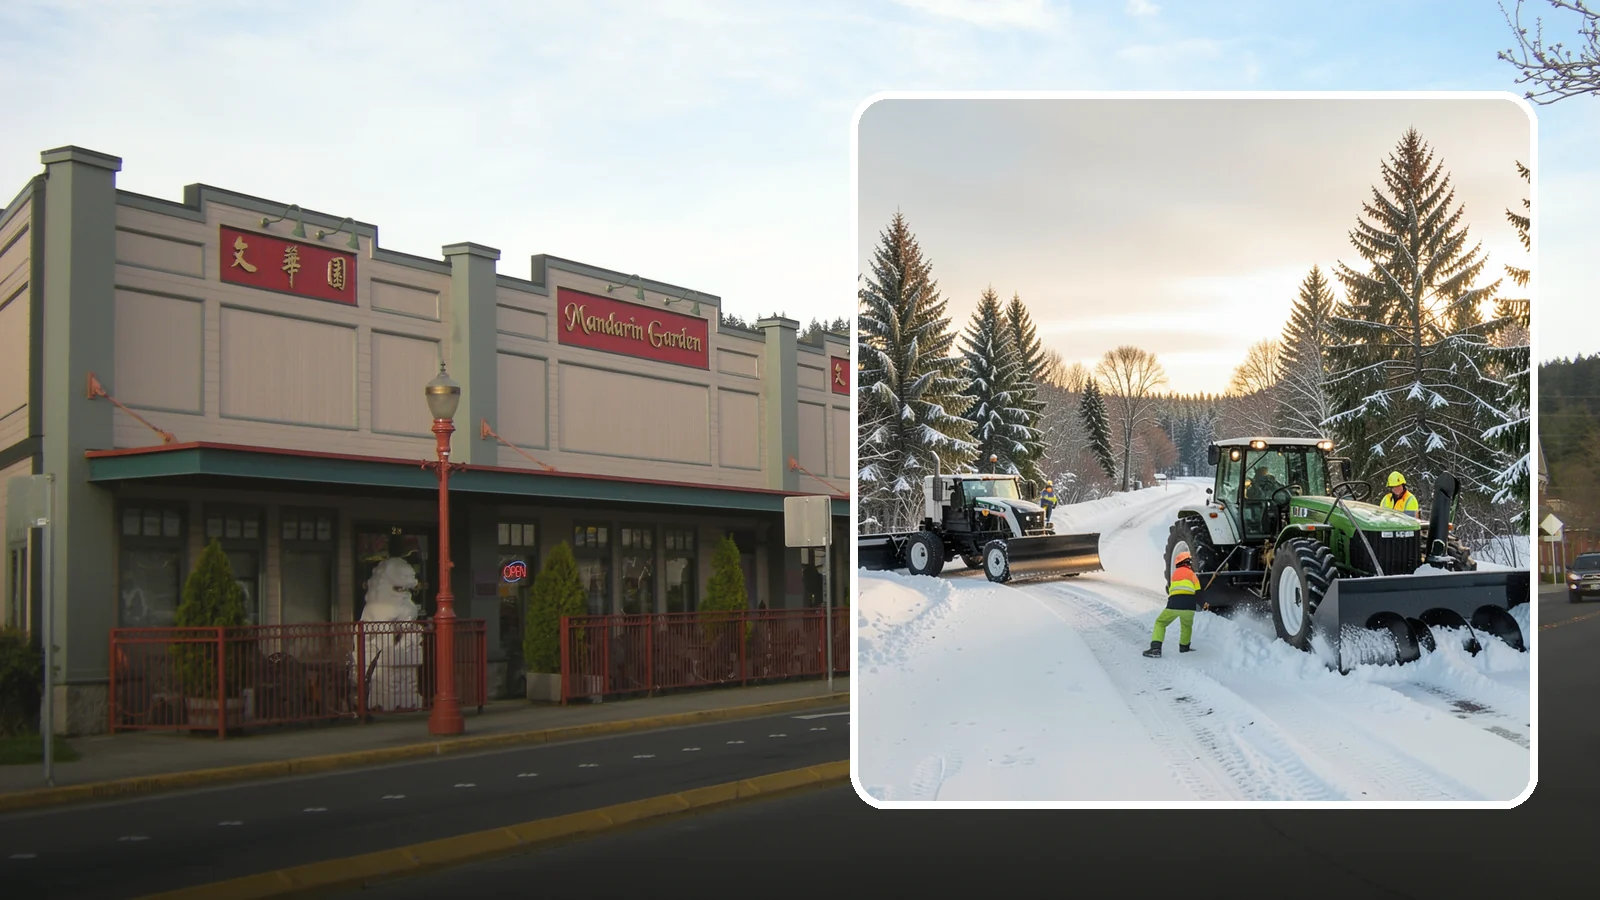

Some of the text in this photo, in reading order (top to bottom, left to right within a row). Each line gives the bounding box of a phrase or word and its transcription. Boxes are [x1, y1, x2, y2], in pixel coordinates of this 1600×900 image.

[230, 235, 346, 291] 文華園
[564, 302, 702, 352] Mandarin Garden
[503, 565, 527, 578] OPEN
